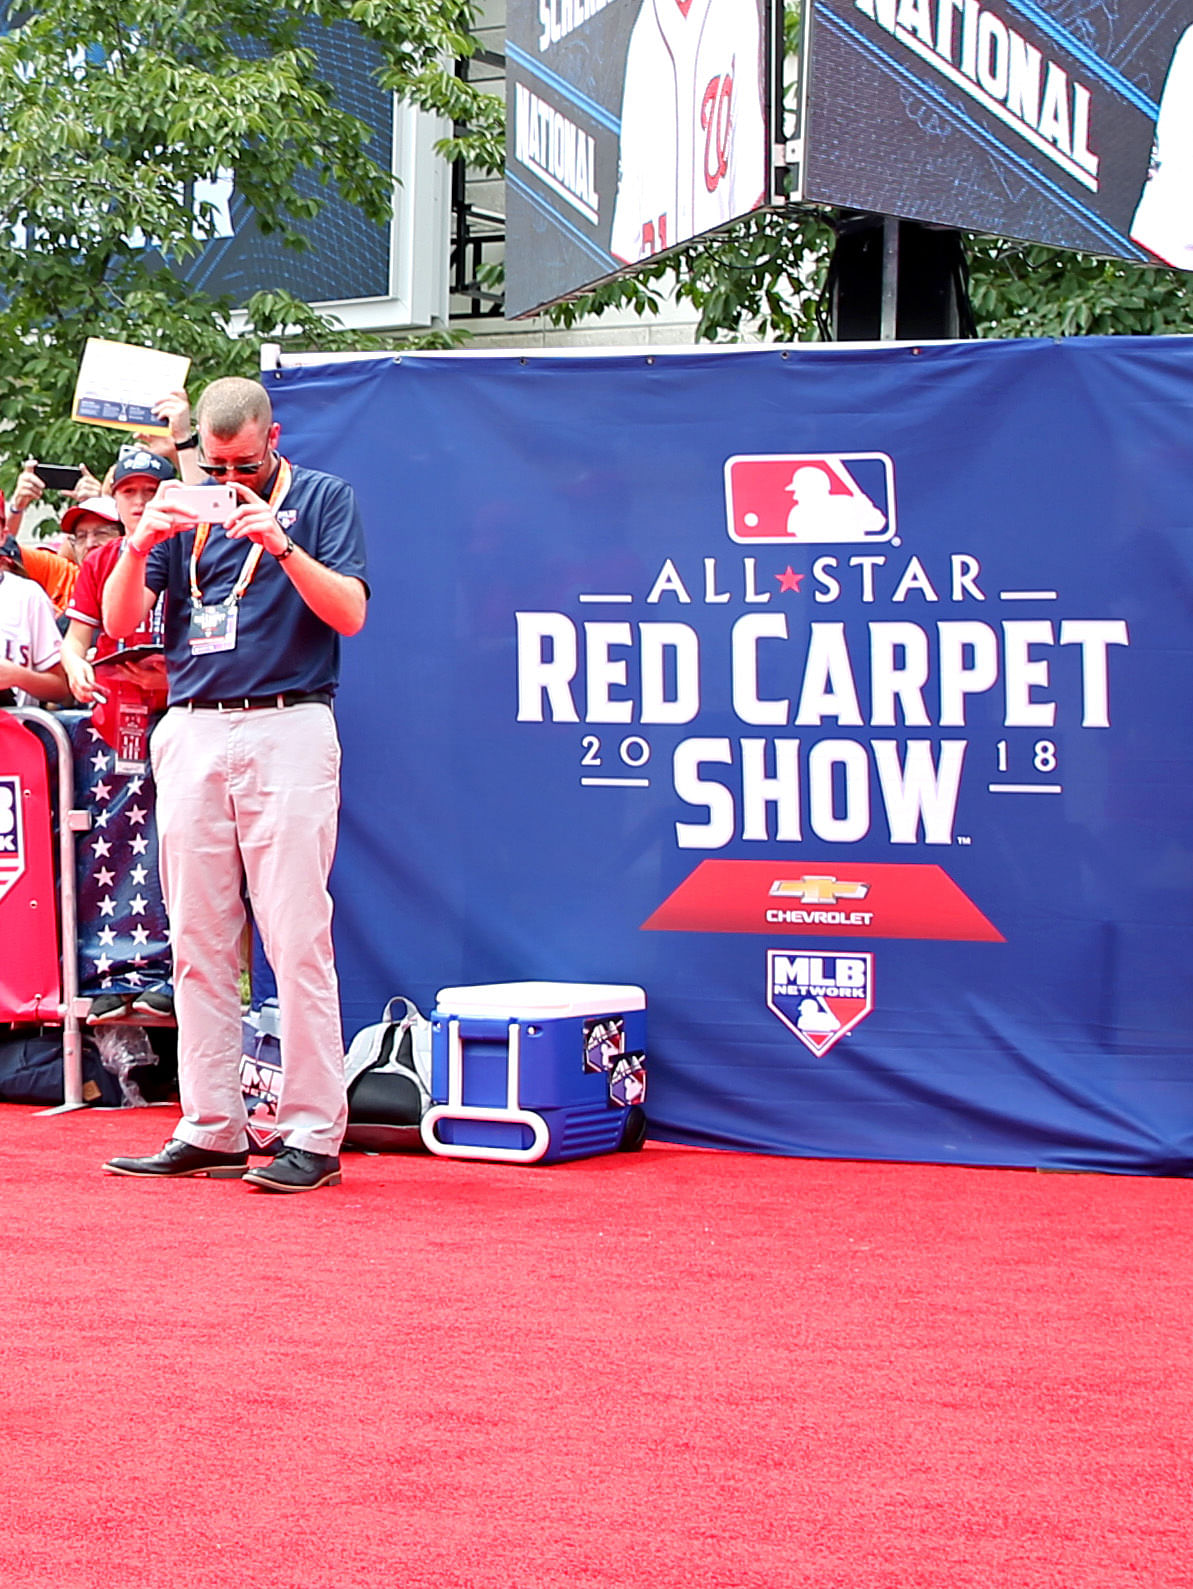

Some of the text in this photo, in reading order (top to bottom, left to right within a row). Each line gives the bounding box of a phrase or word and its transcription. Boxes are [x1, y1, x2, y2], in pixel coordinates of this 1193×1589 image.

[514, 80, 600, 213] NATIONAL
[646, 553, 987, 604] ALL STAR
[514, 610, 1130, 728] RED CARPET
[580, 735, 651, 768] 20
[996, 739, 1058, 773] 18
[672, 736, 968, 850] SHOW
[765, 910, 874, 926] CHEVROLET
[774, 956, 866, 988] MLB
[774, 984, 865, 999] NETWORK
